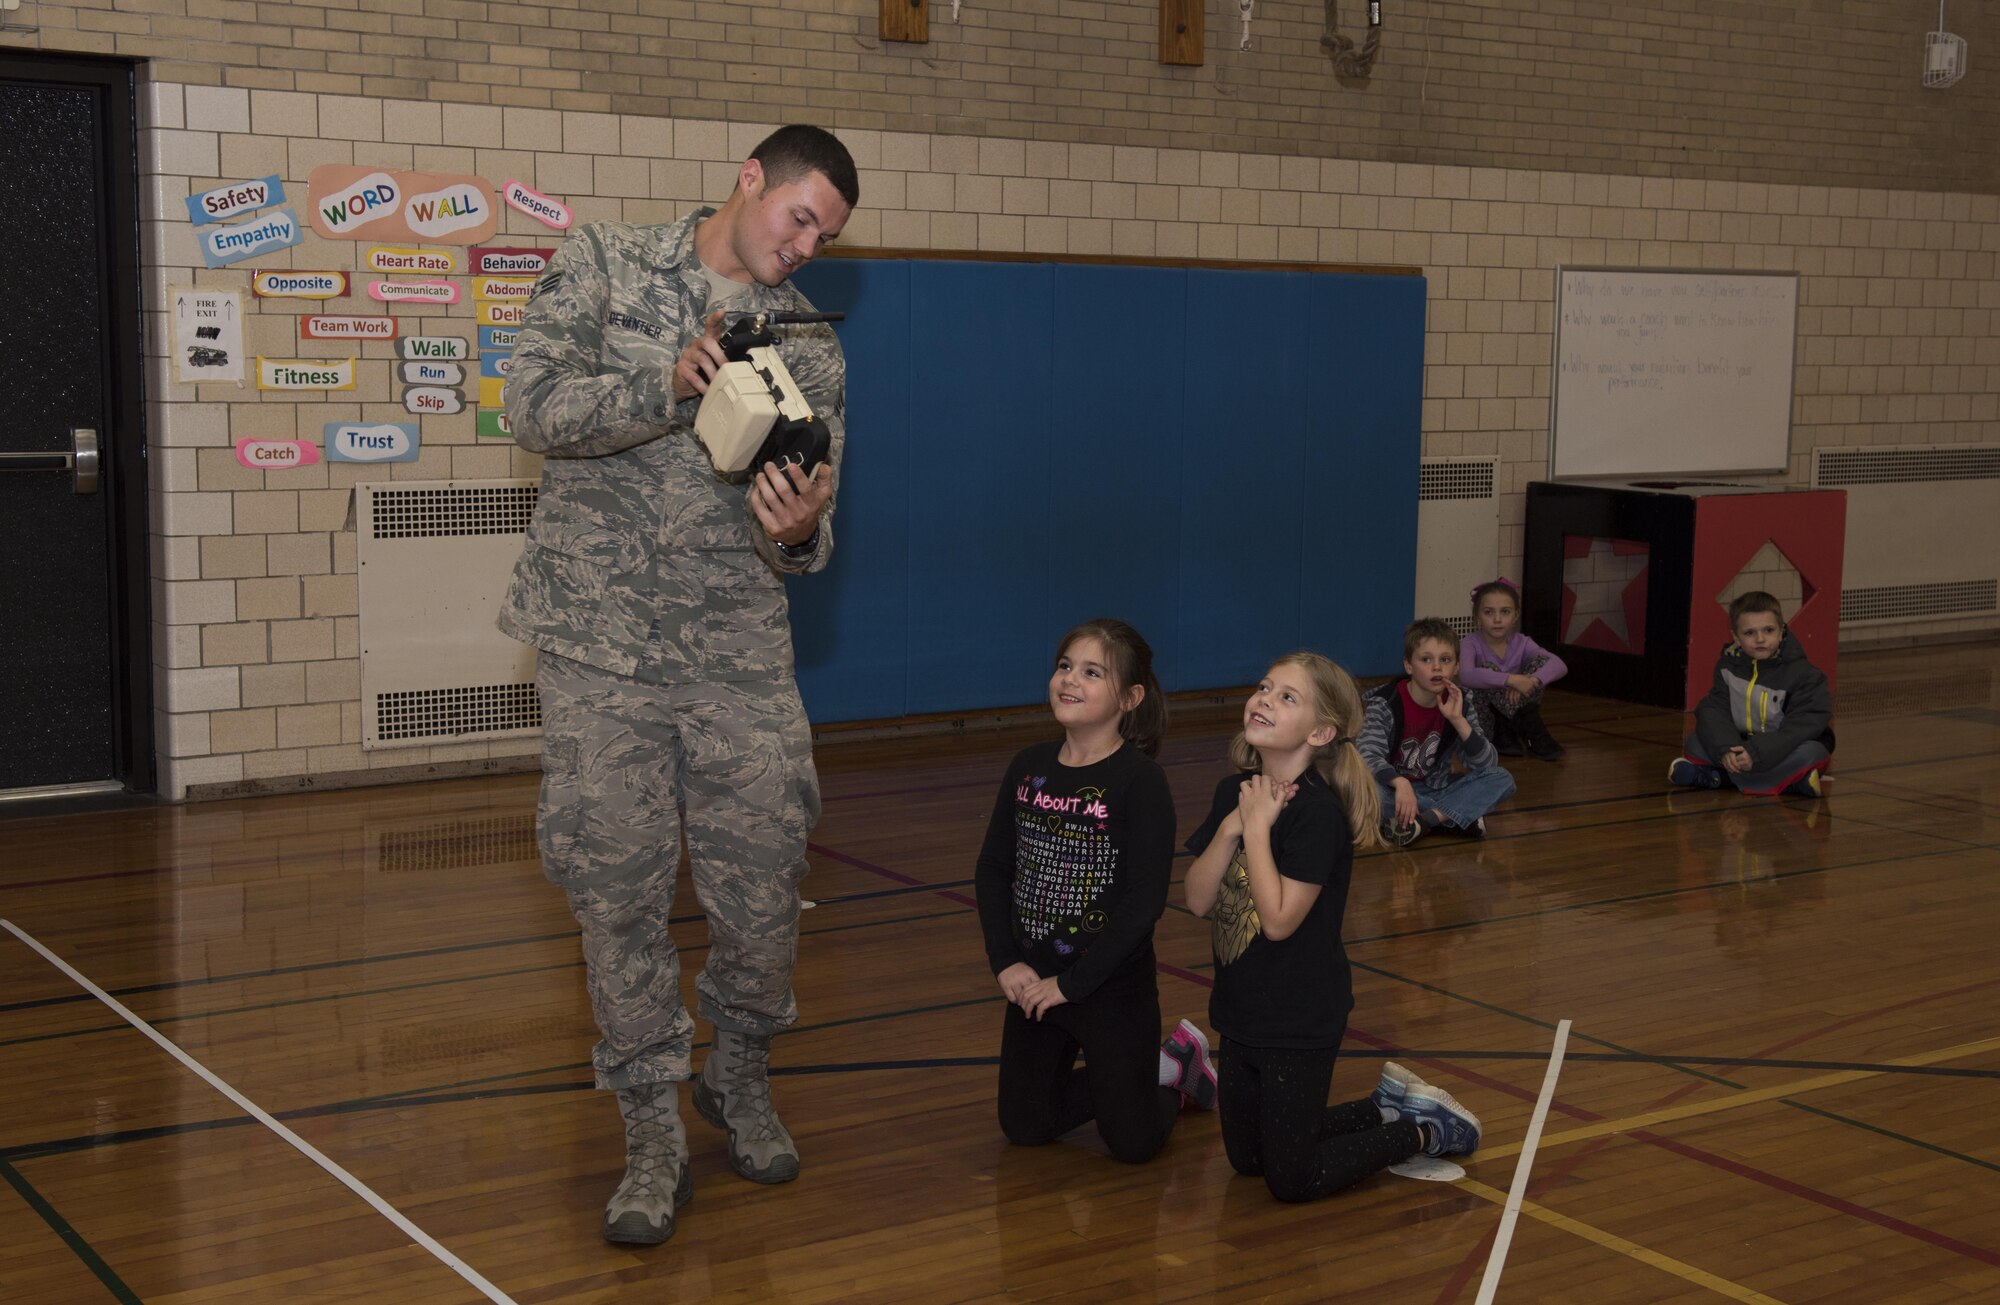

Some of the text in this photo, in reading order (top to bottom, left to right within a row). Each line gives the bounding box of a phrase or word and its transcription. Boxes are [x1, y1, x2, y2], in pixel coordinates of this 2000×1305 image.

[205, 184, 265, 214] Safety
[323, 184, 479, 225] WORD WALL
[513, 189, 562, 222] Respect
[215, 222, 290, 250] Empathy
[376, 254, 449, 270] Heart Rate
[483, 256, 542, 270] Behavior
[268, 276, 333, 291] Opposite
[380, 284, 449, 296] Communicate
[197, 299, 217, 308] FIRE
[197, 310, 218, 318] EXIT
[312, 320, 388, 334] Team Work
[412, 340, 457, 358] Walk
[274, 368, 339, 386] Fitness
[420, 366, 446, 380] Run
[417, 394, 445, 412] Skip
[347, 432, 394, 450] Trust
[254, 446, 295, 460] Catch
[1032, 790, 1081, 814] ABOUT
[1082, 799, 1110, 819] ME
